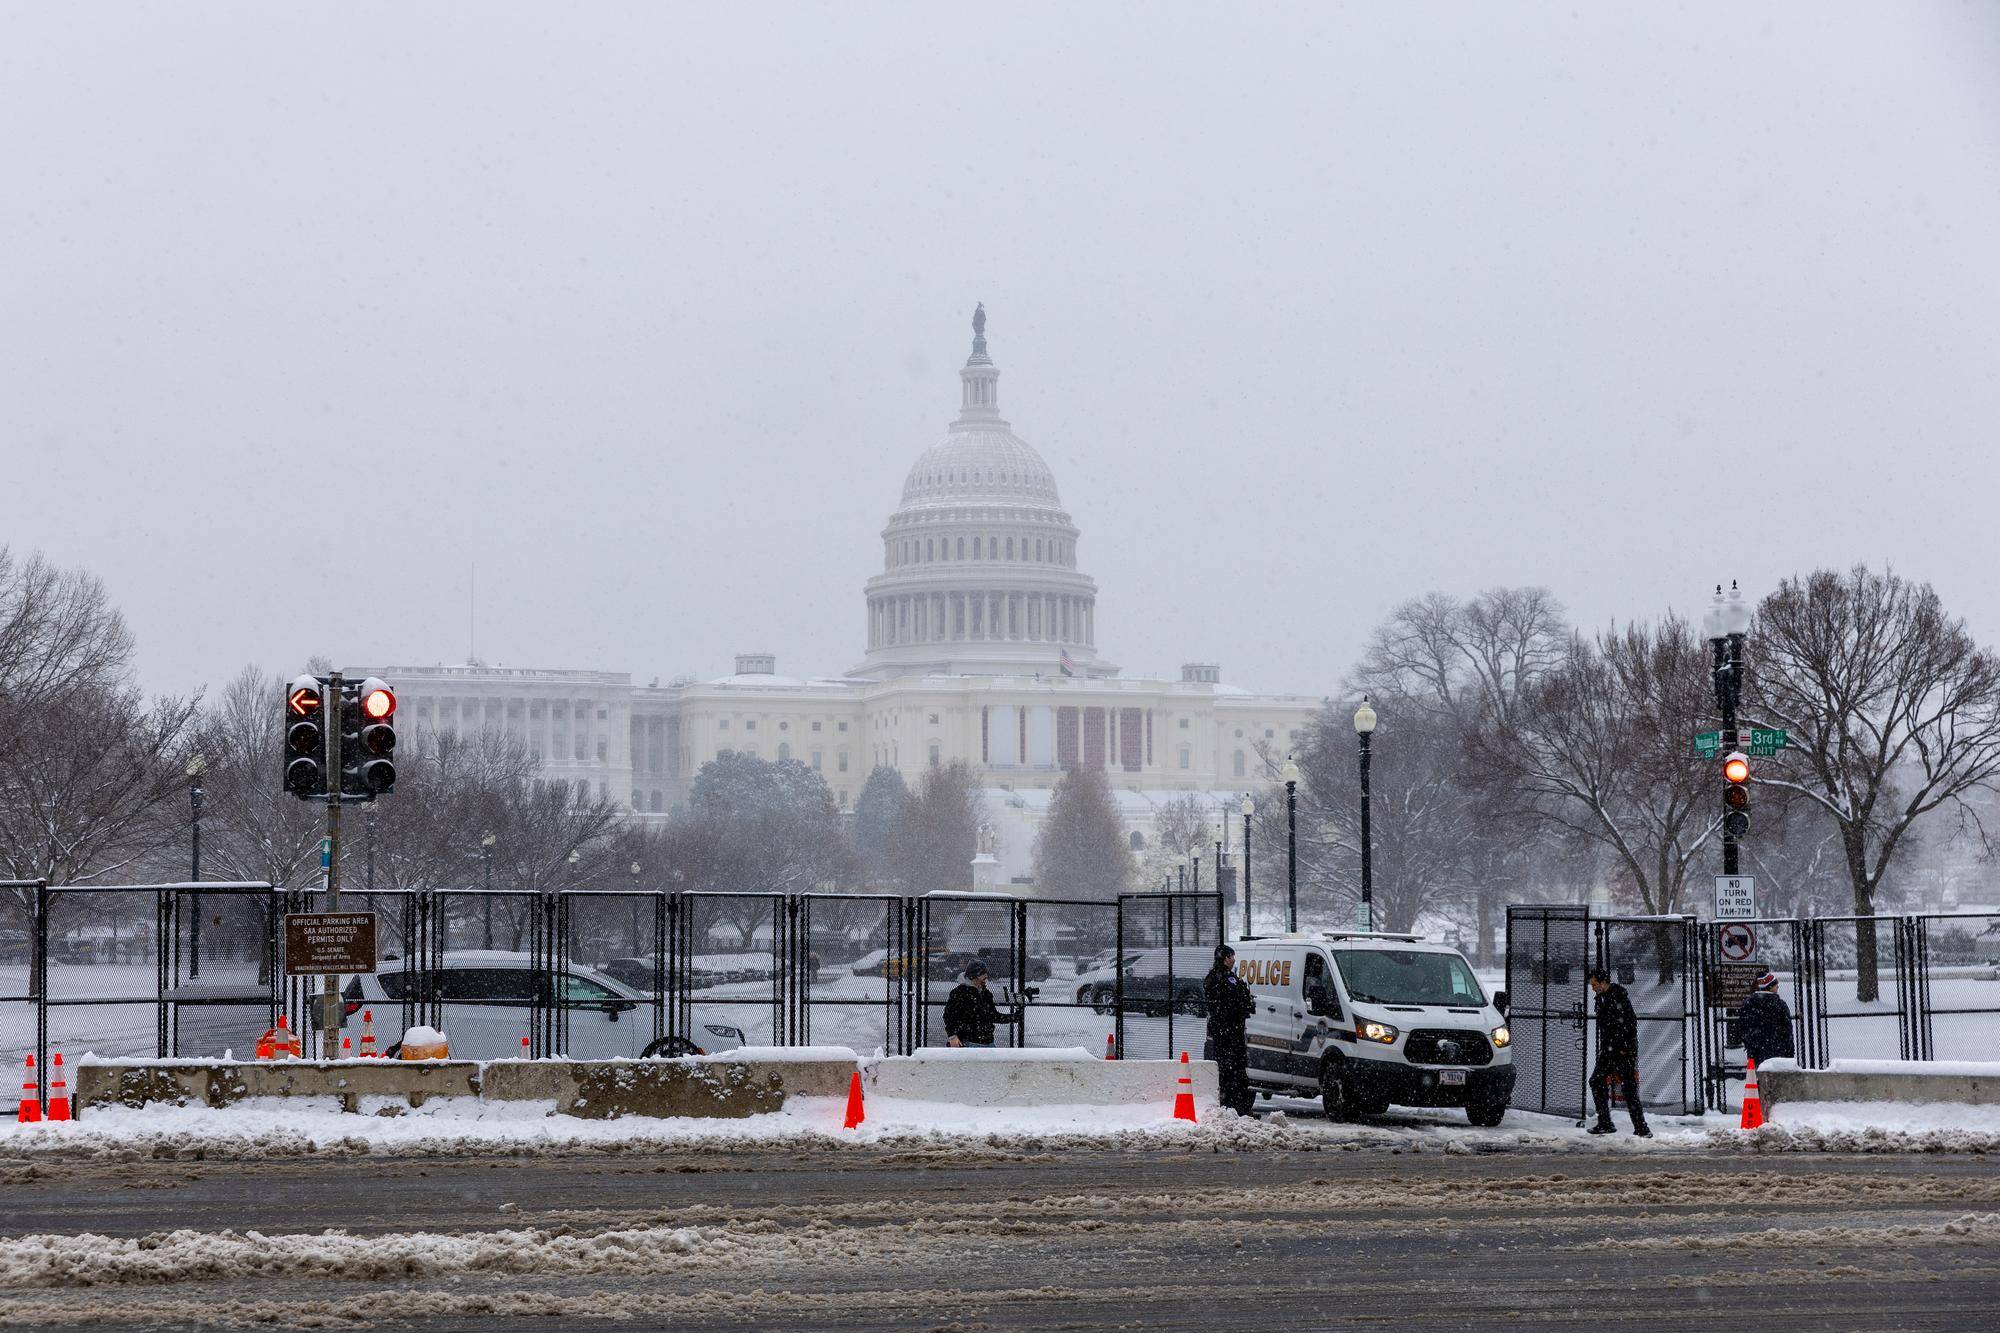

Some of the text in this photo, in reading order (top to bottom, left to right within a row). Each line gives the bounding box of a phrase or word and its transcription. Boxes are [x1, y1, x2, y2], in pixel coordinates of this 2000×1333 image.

[1754, 732, 1773, 744] 3rd
[1748, 747, 1775, 755] UNIT
[1729, 880, 1740, 888] NO
[1720, 908, 1751, 916] 7AM-7PM
[292, 917, 369, 926] OFFICIAL PARKING AREA
[318, 926, 358, 934] AUTHORIZED
[307, 935, 354, 944] PERMITS ONLY
[1239, 960, 1291, 986] POLICE
